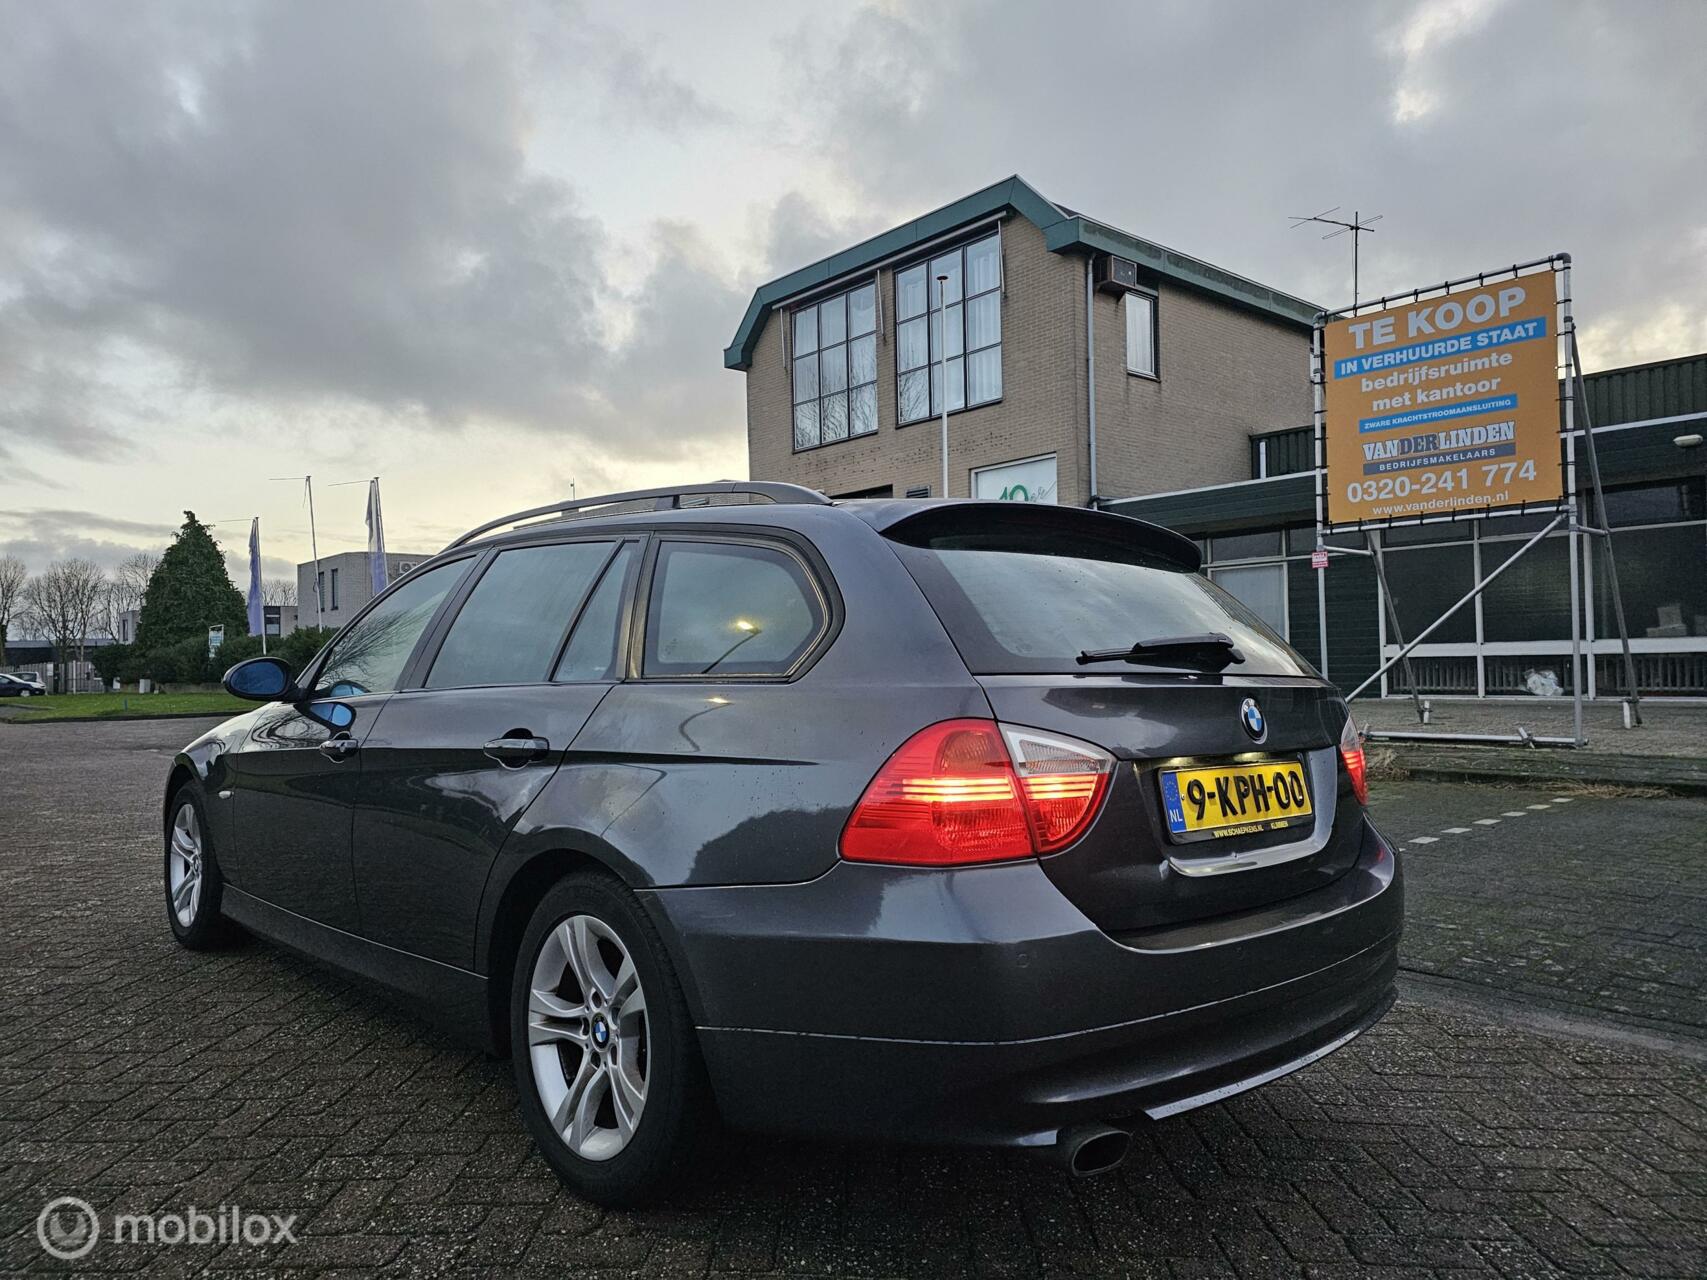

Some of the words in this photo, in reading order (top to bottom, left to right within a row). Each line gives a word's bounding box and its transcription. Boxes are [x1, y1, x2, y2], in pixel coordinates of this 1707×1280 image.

[1348, 316, 1396, 350] TE
[1407, 286, 1526, 338] KOOP
[1340, 360, 1358, 375] IN
[1360, 335, 1472, 373] VERHUURDE
[1476, 322, 1537, 346] STAAT
[1360, 352, 1513, 393] bedrijfsruimte
[1372, 392, 1412, 412] met
[1416, 376, 1501, 404] kantoor
[1364, 419, 1391, 430] ZWARE
[1391, 399, 1511, 424] KRACHTSTROOMAANSLUITING
[1379, 448, 1496, 471] BEDRIJFSMAKELAARS
[1347, 468, 1469, 503] 0320-241
[1482, 459, 1537, 488] 774
[1372, 490, 1509, 515] www.vanderlinden.nl
[1187, 770, 1305, 821] 9-KPH-00
[1169, 810, 1183, 822] NL
